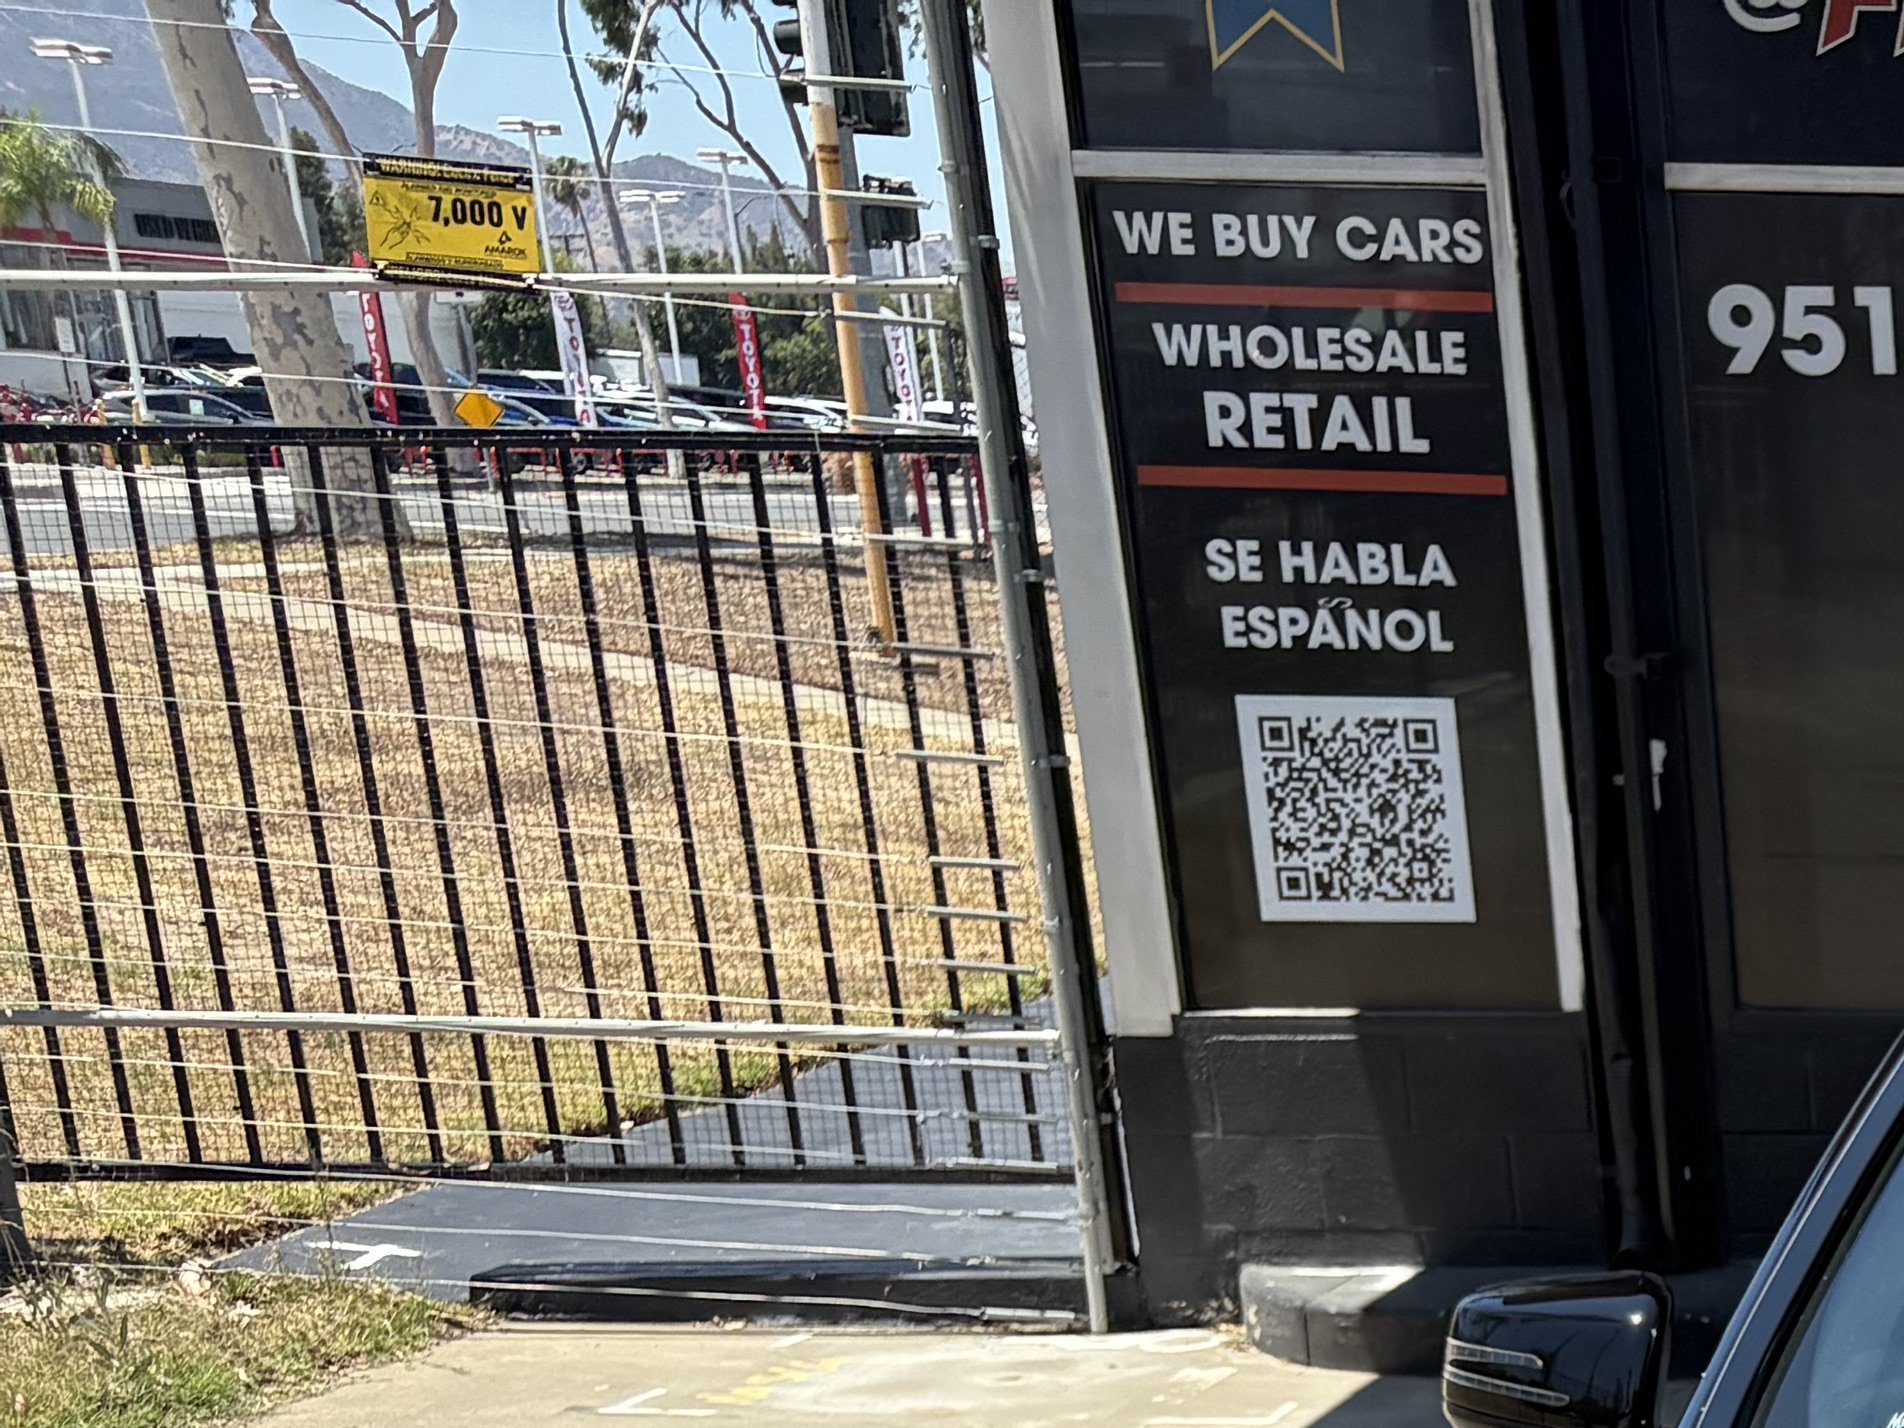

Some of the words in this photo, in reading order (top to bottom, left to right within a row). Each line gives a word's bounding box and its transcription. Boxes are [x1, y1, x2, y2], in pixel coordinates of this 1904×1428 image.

[427, 195, 504, 227] 7,000
[511, 205, 528, 231] V
[1113, 211, 1196, 255] WE
[1212, 213, 1316, 258] BUY
[1336, 216, 1483, 263] CARS
[1152, 320, 1467, 375] WHOLESALE
[1203, 390, 1430, 453] RETAIL
[1205, 538, 1263, 582] SE
[1278, 540, 1457, 587] HABLA
[1220, 597, 1454, 652] ESPAÑOL
